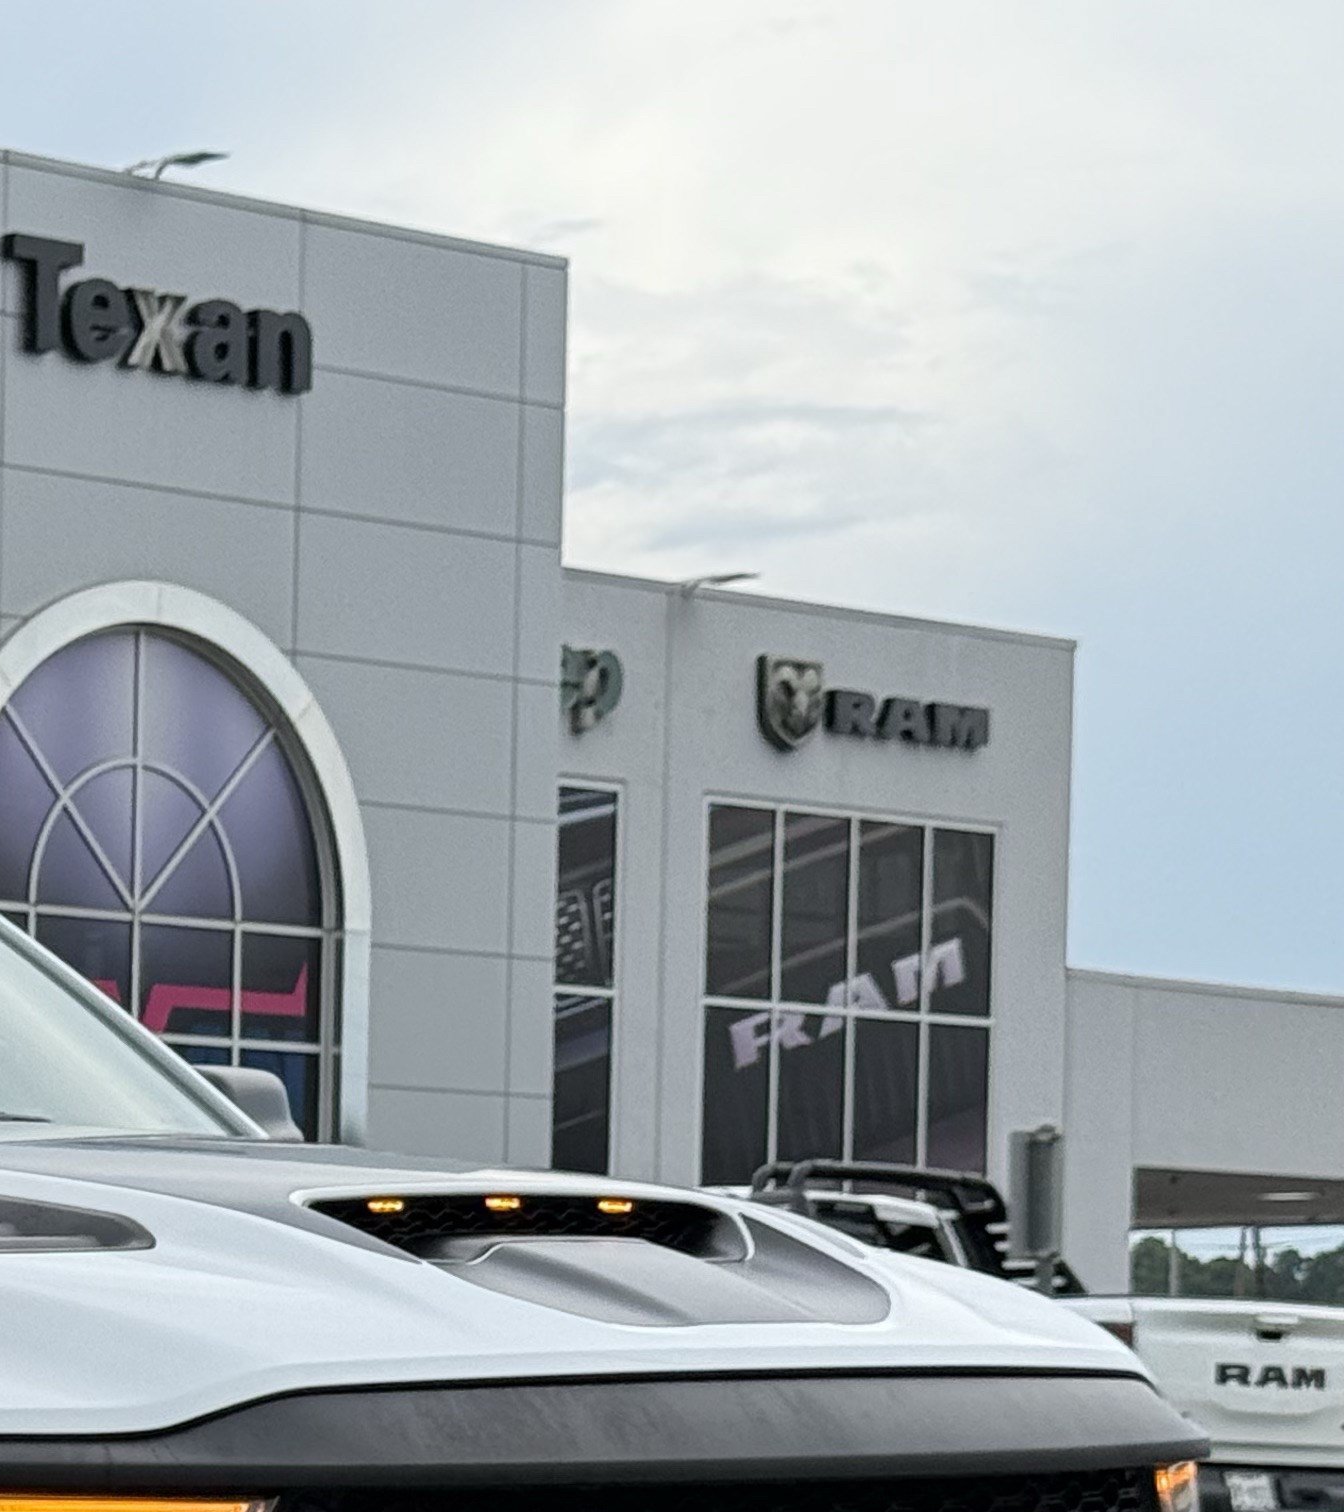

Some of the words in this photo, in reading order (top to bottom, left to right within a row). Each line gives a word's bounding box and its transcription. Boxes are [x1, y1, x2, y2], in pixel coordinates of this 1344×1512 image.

[0, 233, 312, 396] Texan
[823, 688, 990, 751] RAM
[728, 936, 967, 1071] RAM
[1214, 1362, 1327, 1391] RAM
